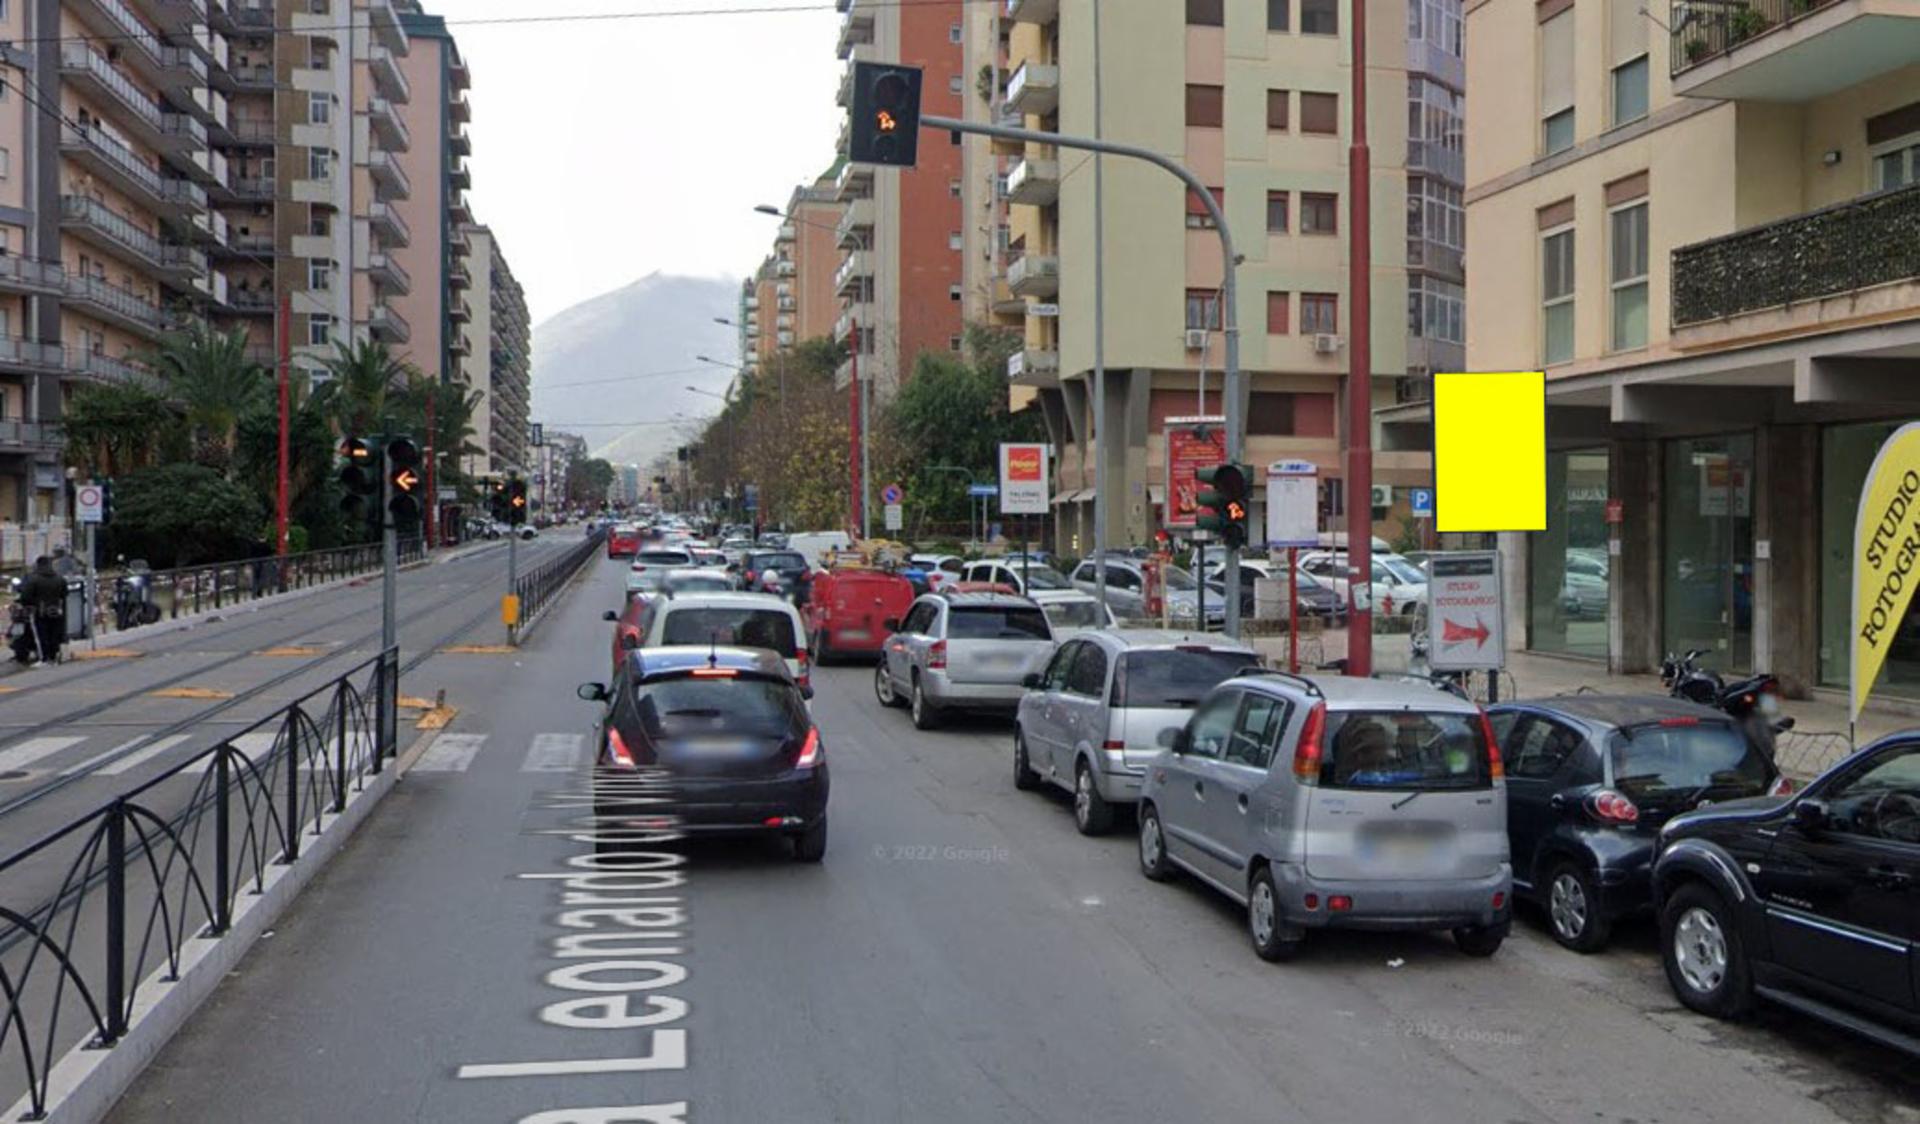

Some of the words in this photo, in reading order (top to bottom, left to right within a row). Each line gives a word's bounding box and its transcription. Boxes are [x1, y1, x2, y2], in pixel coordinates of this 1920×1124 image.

[1416, 491, 1428, 508] P
[1866, 469, 1919, 570] STUDIO
[1446, 581, 1480, 592] STUDIO
[1435, 595, 1496, 608] FOTOGRAFICO
